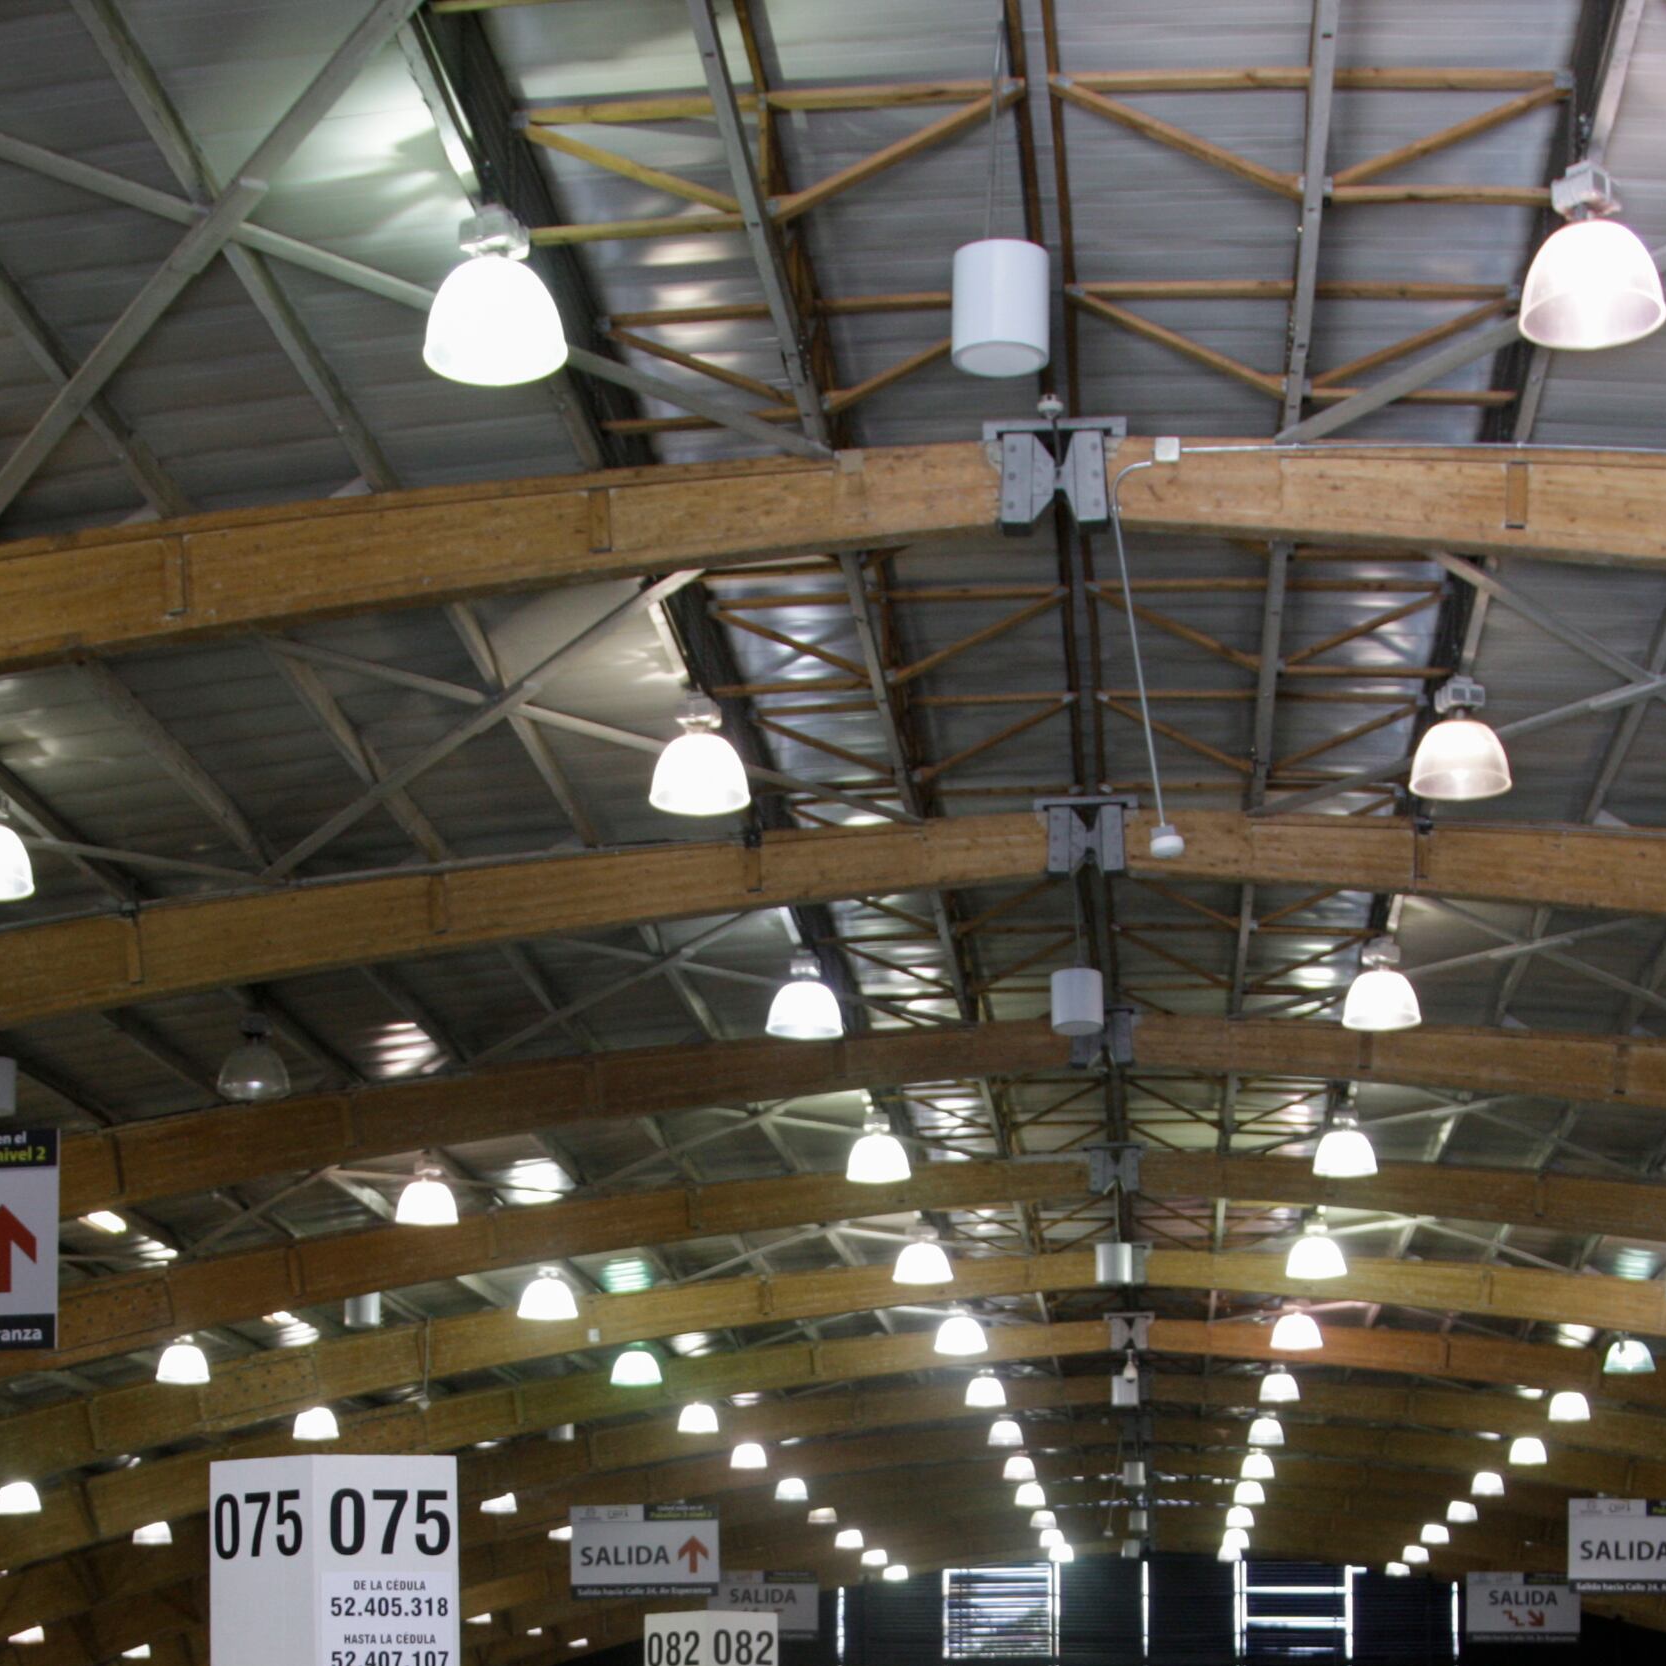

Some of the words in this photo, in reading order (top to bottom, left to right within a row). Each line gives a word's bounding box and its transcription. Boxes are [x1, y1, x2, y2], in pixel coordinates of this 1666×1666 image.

[15, 1130, 27, 1144] el
[36, 1146, 46, 1161] 2
[214, 1489, 303, 1560] 075
[330, 1488, 451, 1556] 075
[581, 1546, 669, 1566] SALIDA
[353, 1580, 367, 1591] DE
[370, 1580, 383, 1591] LA
[386, 1579, 426, 1591] CÉDULA
[730, 1589, 796, 1604] SALIDA
[1489, 1590, 1558, 1605] SALIDA
[331, 1597, 448, 1617] 52.405.318
[344, 1634, 377, 1644] HASTA
[380, 1634, 393, 1644] LA
[396, 1632, 436, 1644] CÉDULA
[648, 1631, 700, 1666] 082
[713, 1629, 774, 1666] 082
